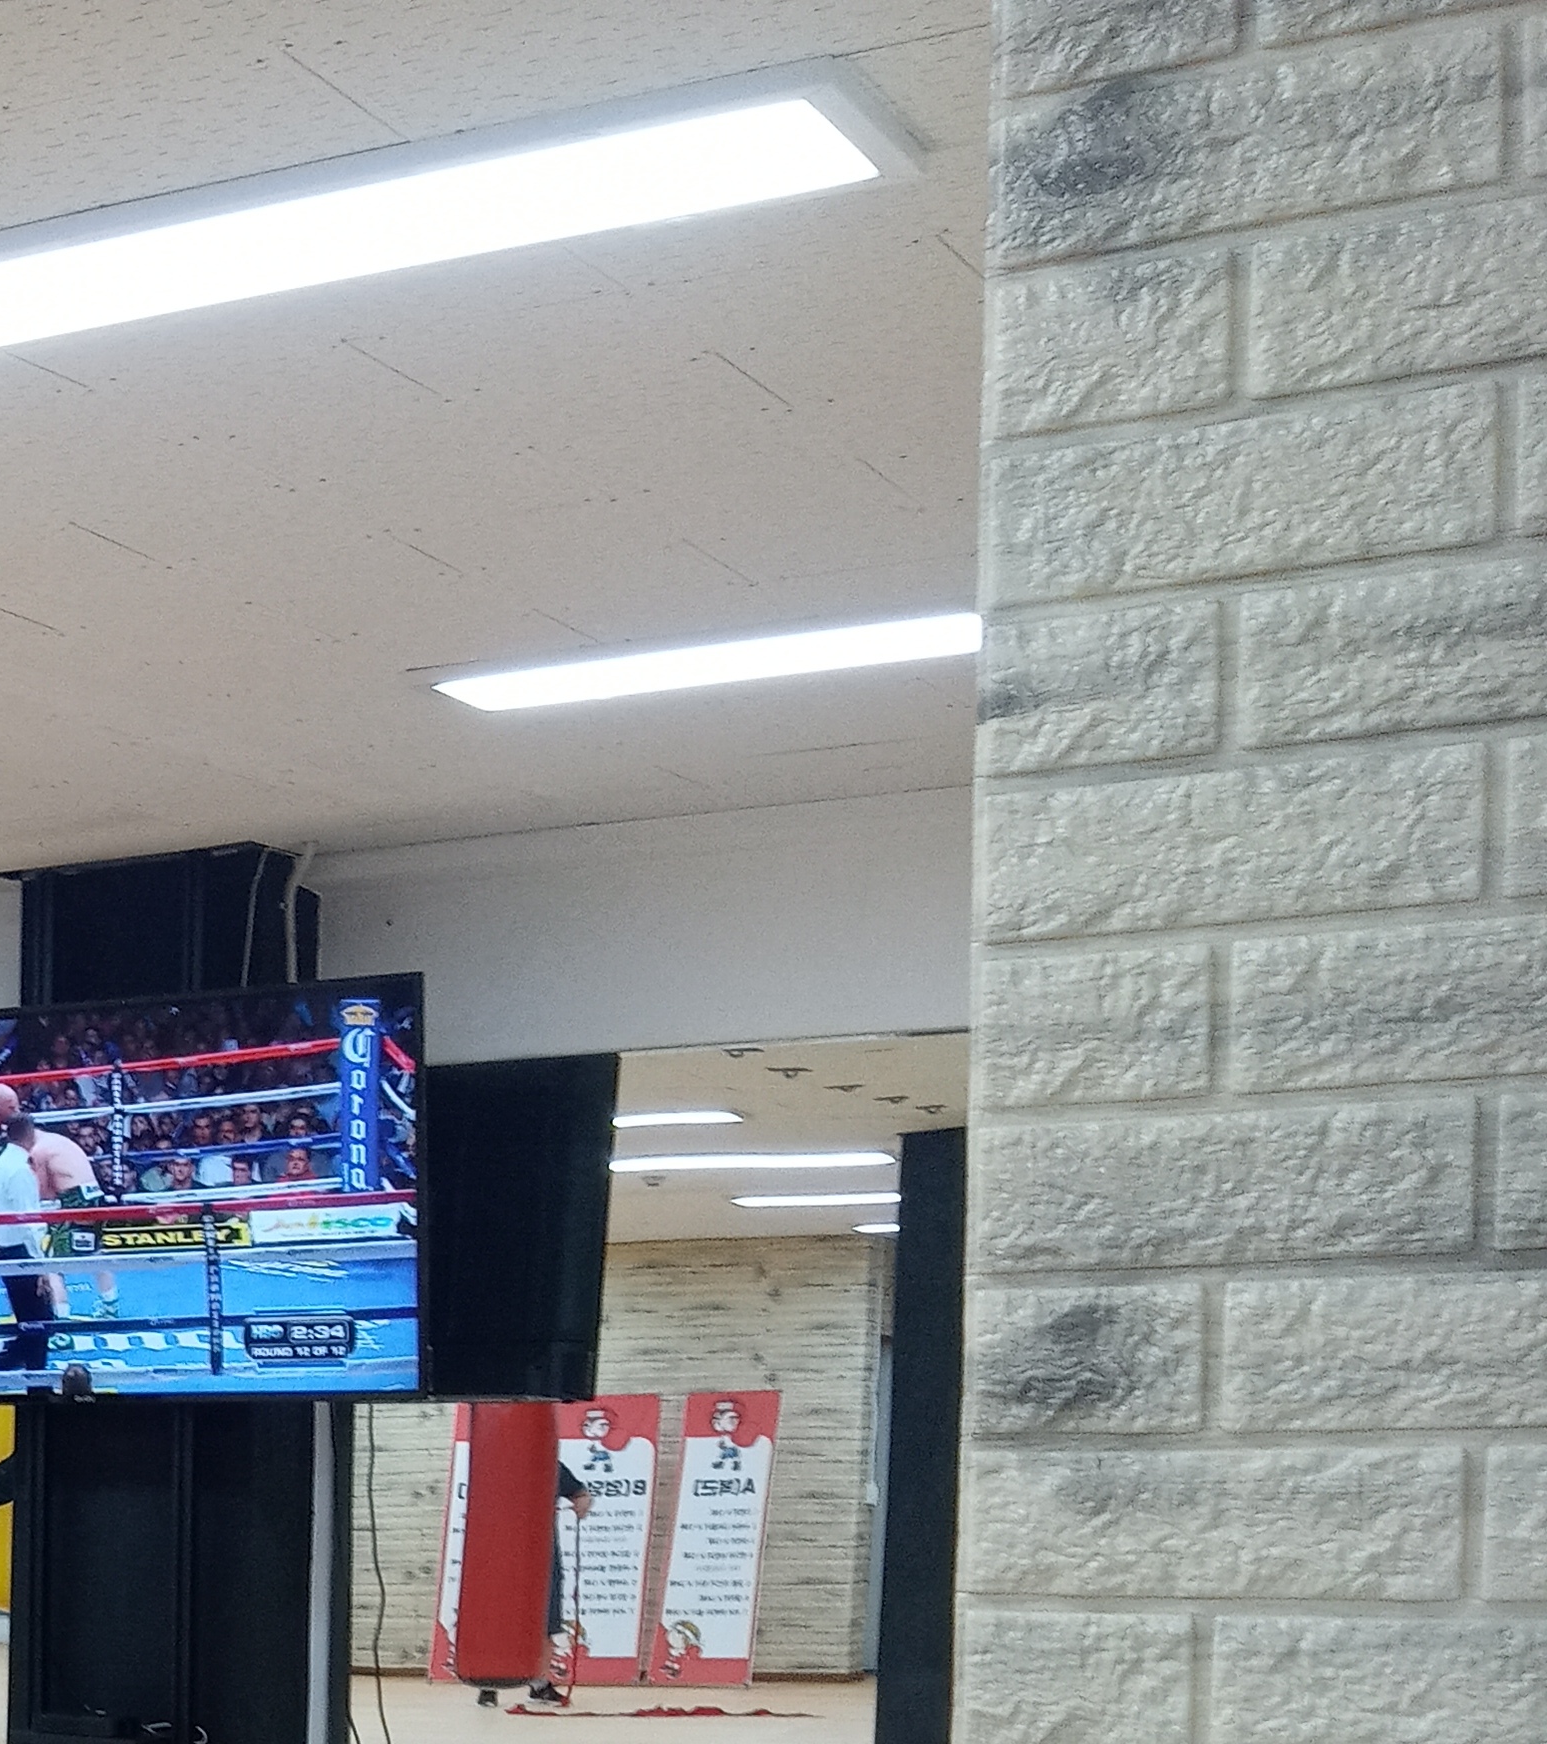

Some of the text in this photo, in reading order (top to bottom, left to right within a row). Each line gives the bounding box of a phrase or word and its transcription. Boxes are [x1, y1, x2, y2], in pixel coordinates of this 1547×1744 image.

[342, 1028, 374, 1191] Corona
[102, 1229, 231, 1247] STANLEY
[290, 1325, 346, 1339] 2:34
[251, 1346, 293, 1357] ROUND
[294, 1346, 311, 1357] 12
[312, 1345, 328, 1356] OF
